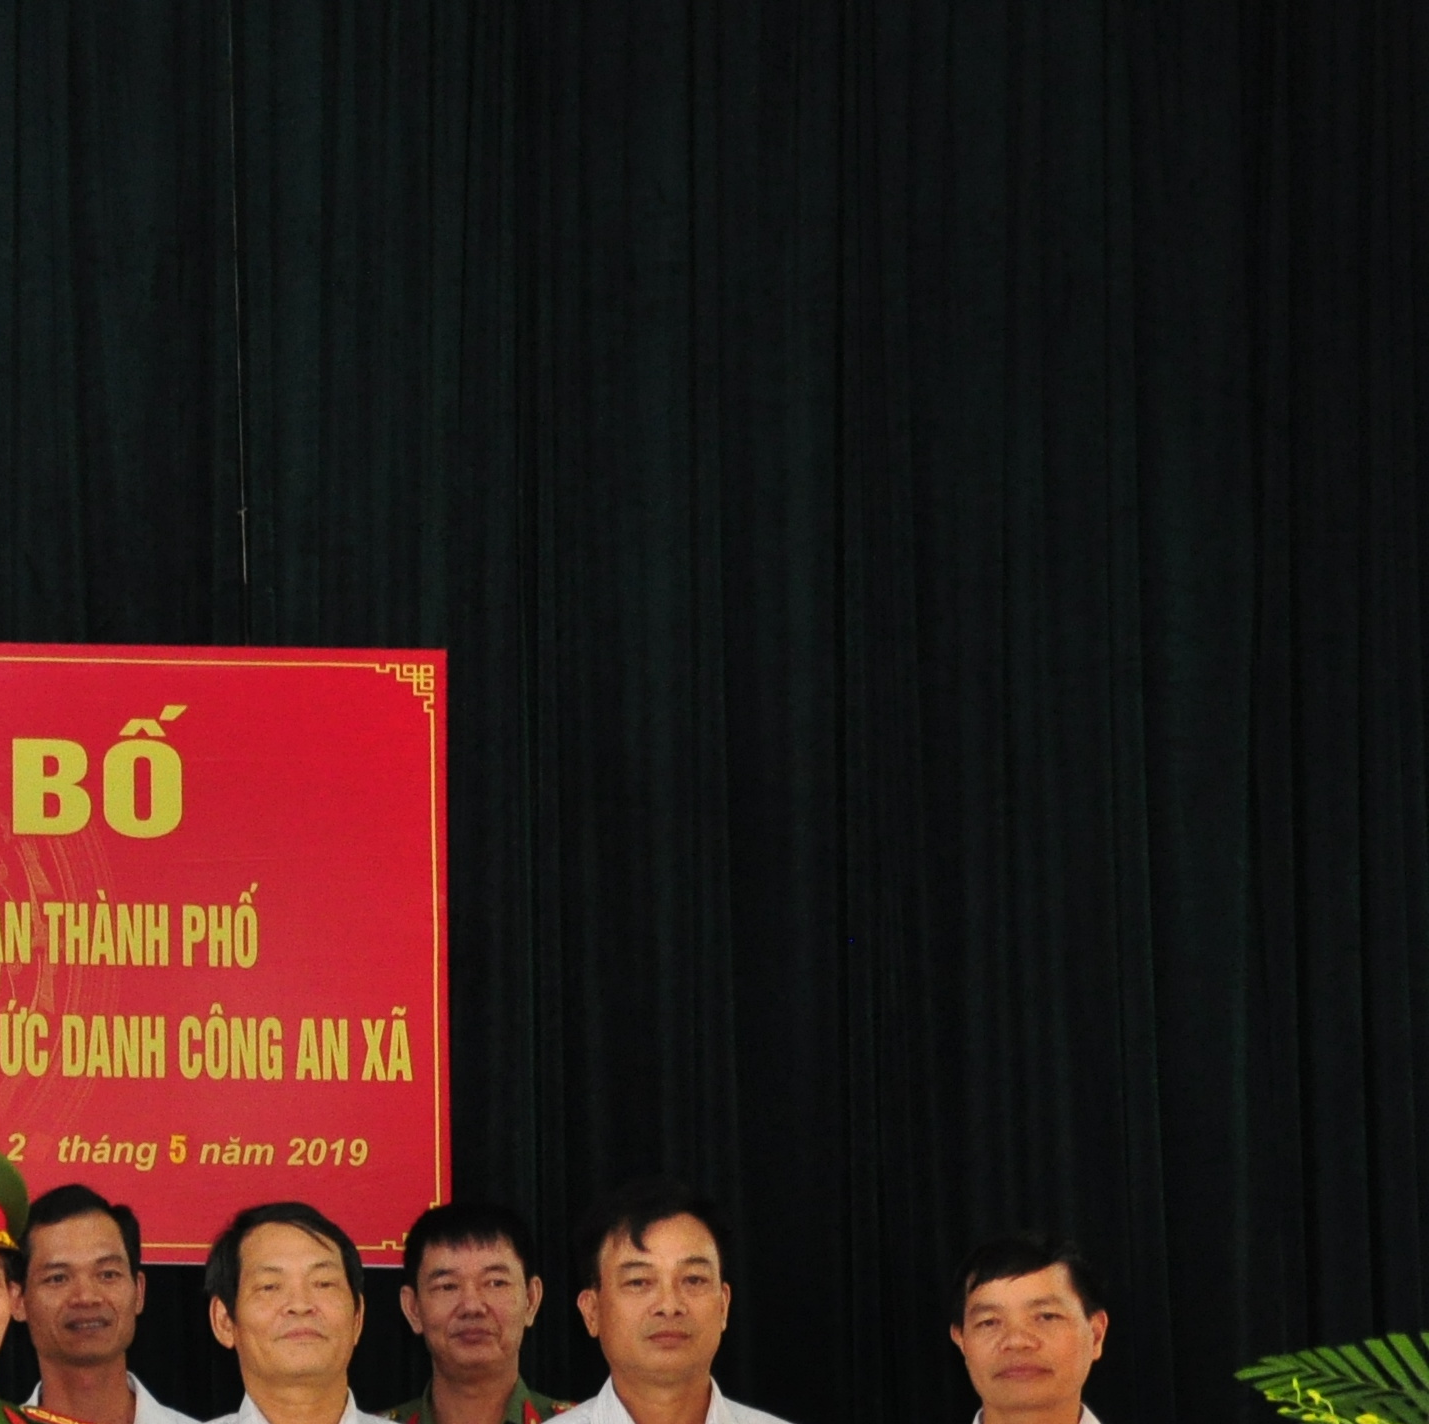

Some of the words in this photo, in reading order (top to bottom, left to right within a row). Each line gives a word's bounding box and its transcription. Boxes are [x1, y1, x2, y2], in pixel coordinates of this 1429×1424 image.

[11, 705, 187, 839] BỐ
[43, 889, 169, 967] THÀNH
[182, 882, 259, 968] PHỐ
[62, 1014, 166, 1078] DANH
[179, 1002, 284, 1081] CÔNG
[296, 1017, 349, 1081] AN
[361, 1006, 413, 1082] XÃ
[6, 1132, 27, 1162] 2
[58, 1134, 158, 1172] tháng
[169, 1134, 188, 1164] 5
[199, 1136, 275, 1166] năm
[287, 1138, 369, 1167] 2019
